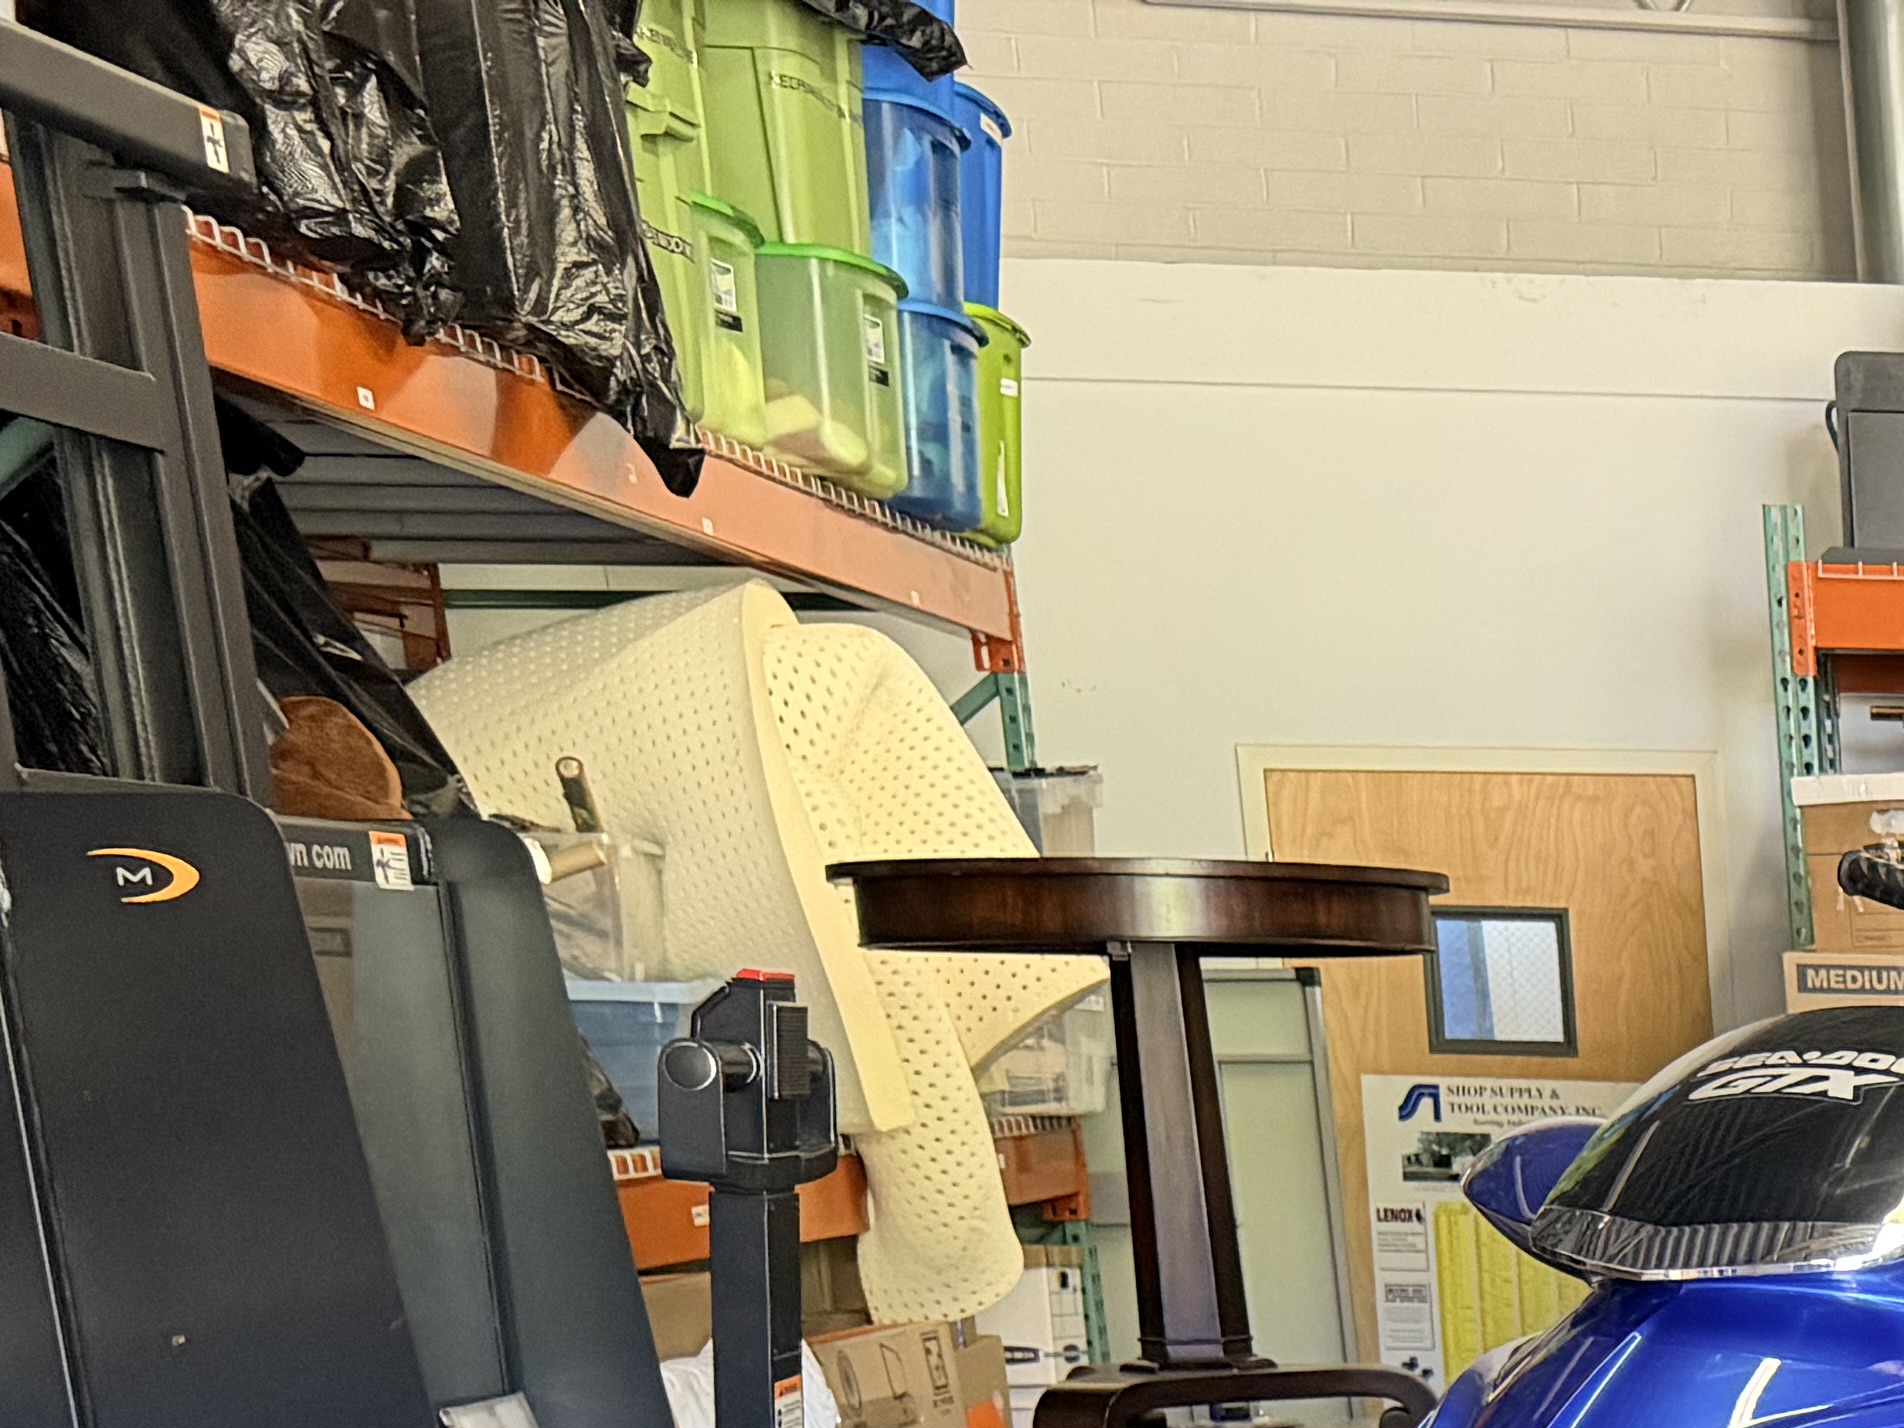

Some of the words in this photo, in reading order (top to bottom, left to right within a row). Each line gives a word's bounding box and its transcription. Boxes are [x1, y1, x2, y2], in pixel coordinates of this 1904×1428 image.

[1688, 1067, 1900, 1101] GTX
[1446, 1085, 1488, 1098] SHOP
[1489, 1085, 1545, 1100] SUPPLY
[1449, 1101, 1491, 1115] TOOL
[1375, 1207, 1414, 1223] LENOX
